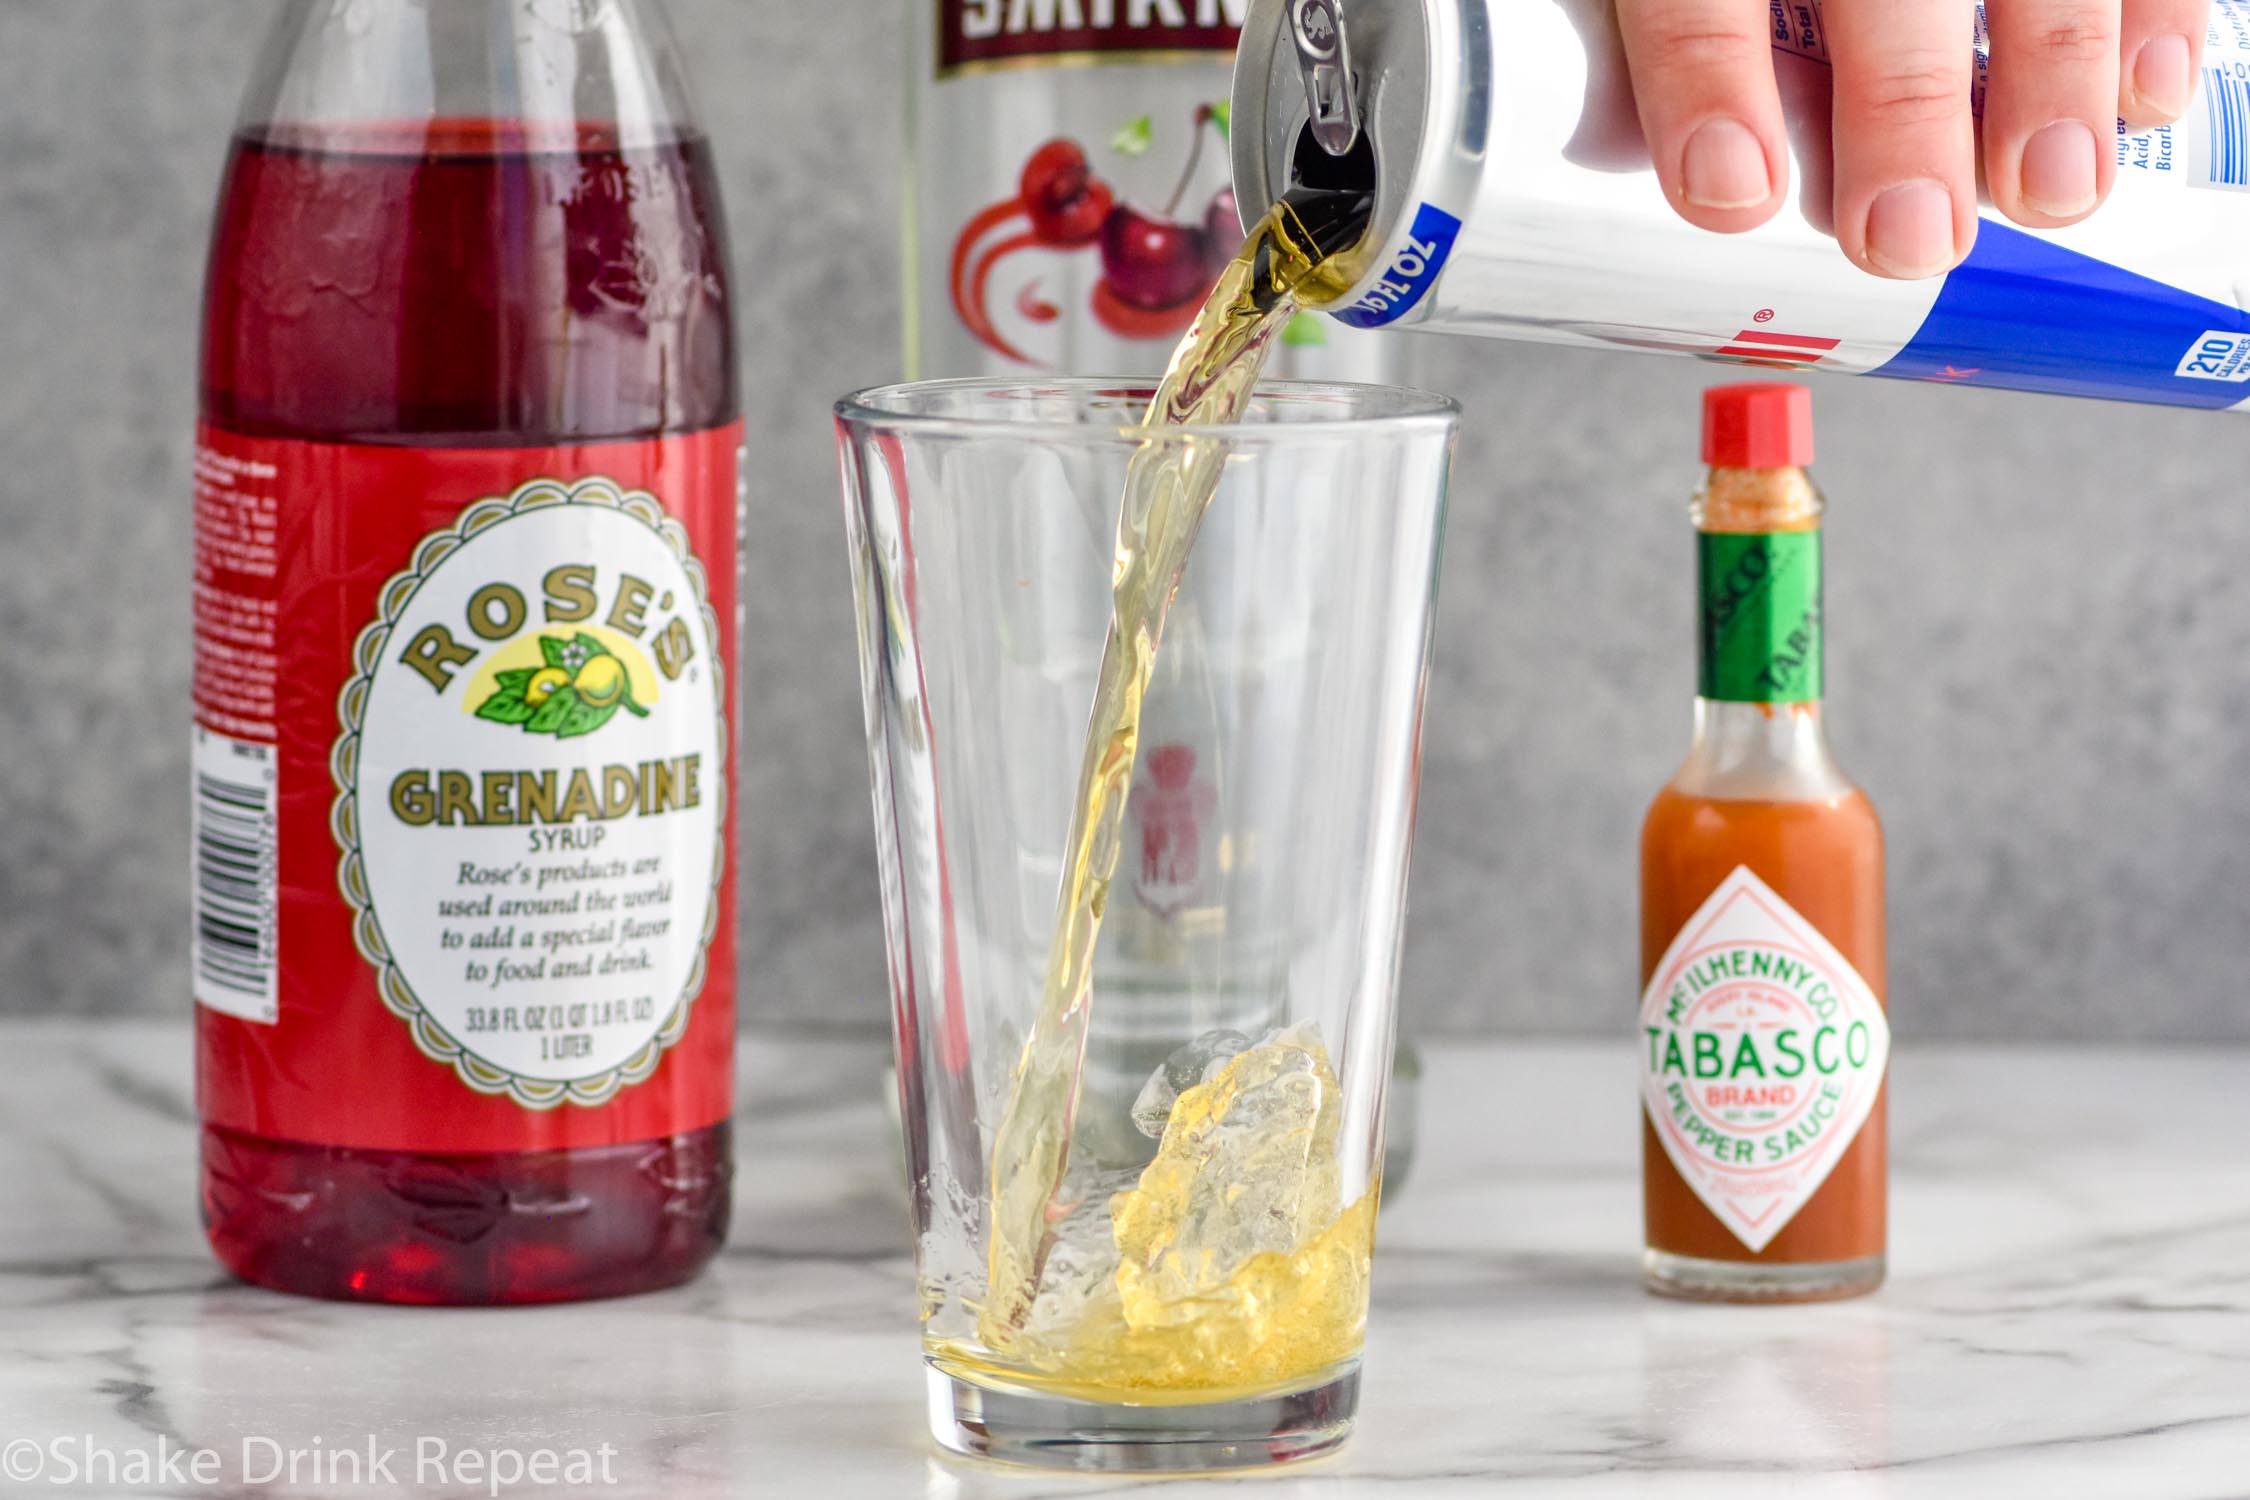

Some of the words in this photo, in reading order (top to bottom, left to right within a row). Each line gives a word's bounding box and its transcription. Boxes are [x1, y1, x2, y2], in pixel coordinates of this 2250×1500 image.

[1794, 5, 1816, 49] Total
[2132, 134, 2153, 169] Acid,
[1392, 235, 1437, 278] OZ
[1377, 279, 1412, 303] FL
[2186, 339, 2234, 374] 210
[398, 563, 695, 695] ROSE'S
[389, 752, 702, 828] GRENADINE
[528, 825, 607, 853] SYRUP
[457, 861, 533, 887] Rose's
[538, 857, 627, 891] products
[632, 856, 662, 875] are
[438, 894, 492, 917] used
[499, 889, 580, 917] around
[585, 887, 618, 913] the
[623, 881, 673, 907] world
[440, 928, 463, 950] to
[469, 925, 515, 950] add
[520, 930, 535, 949] a
[540, 920, 615, 954] special
[617, 916, 672, 948] flavor
[465, 959, 488, 982] to
[489, 956, 545, 989] food
[550, 953, 593, 979] and
[598, 951, 655, 976] drink.
[465, 1006, 500, 1032] 33.8
[503, 1006, 520, 1031] FL
[523, 1005, 547, 1031] OZ
[540, 1035, 549, 1061] 1
[552, 1033, 594, 1060] LITER
[1643, 1020, 1870, 1080] TABASCO
[1706, 1084, 1796, 1107] BRAND
[1667, 1080, 1754, 1164] PEPPER
[1764, 1081, 1842, 1161] SAUCE
